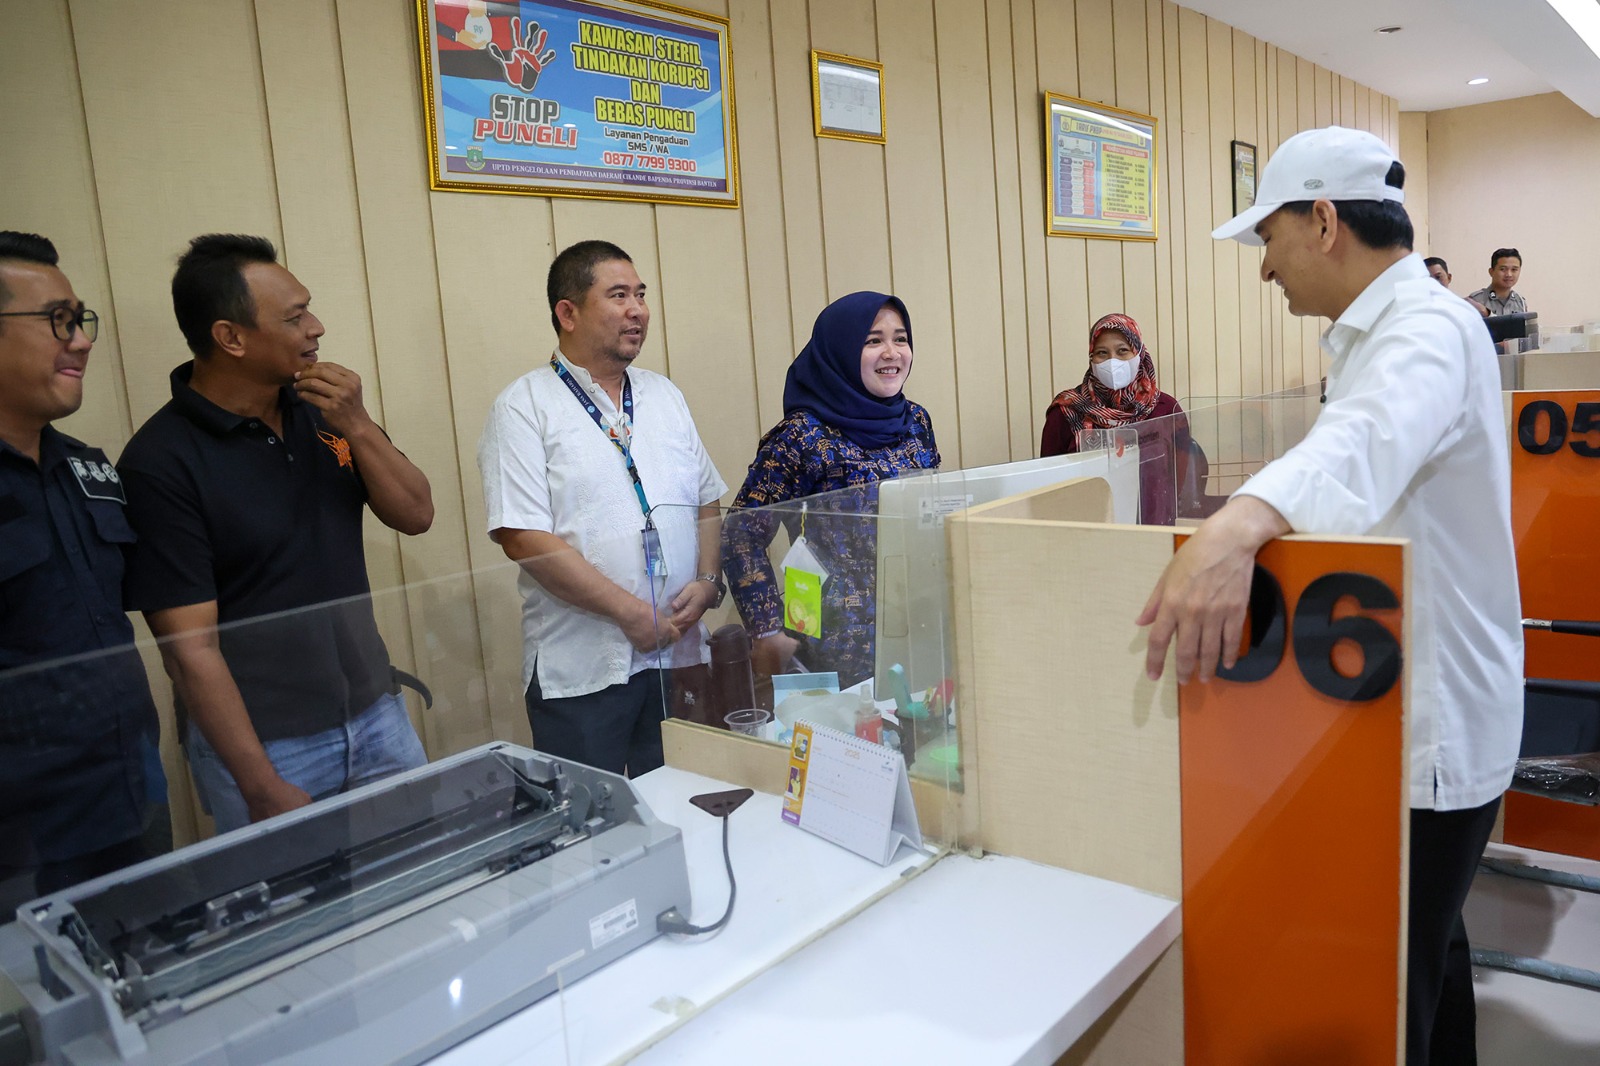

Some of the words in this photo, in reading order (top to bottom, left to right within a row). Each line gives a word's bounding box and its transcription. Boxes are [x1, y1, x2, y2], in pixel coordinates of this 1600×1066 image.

[579, 20, 654, 57] KAWASAN
[655, 36, 701, 65] STERIL
[572, 44, 648, 80] TINDAKAN
[649, 58, 710, 91] KORUPSI
[630, 79, 661, 105] DAN
[492, 93, 559, 125] STOP
[595, 97, 644, 127] BEBAS
[645, 105, 696, 133] PUNGLI
[474, 118, 578, 148] PUNGLI
[604, 127, 642, 141] Layanan
[643, 132, 689, 146] Pengaduan
[627, 141, 648, 152] SMS
[655, 144, 669, 154] WA
[492, 163, 511, 171] UPTD
[511, 164, 558, 175] PENGELOLAAN
[559, 169, 598, 178] PENDAPATAN
[598, 171, 622, 180] DAERAH
[622, 173, 647, 182] CIKANDE
[603, 152, 634, 166] 0877
[636, 155, 665, 169] 7799
[667, 159, 697, 172] 9300
[1518, 400, 1600, 458] 05
